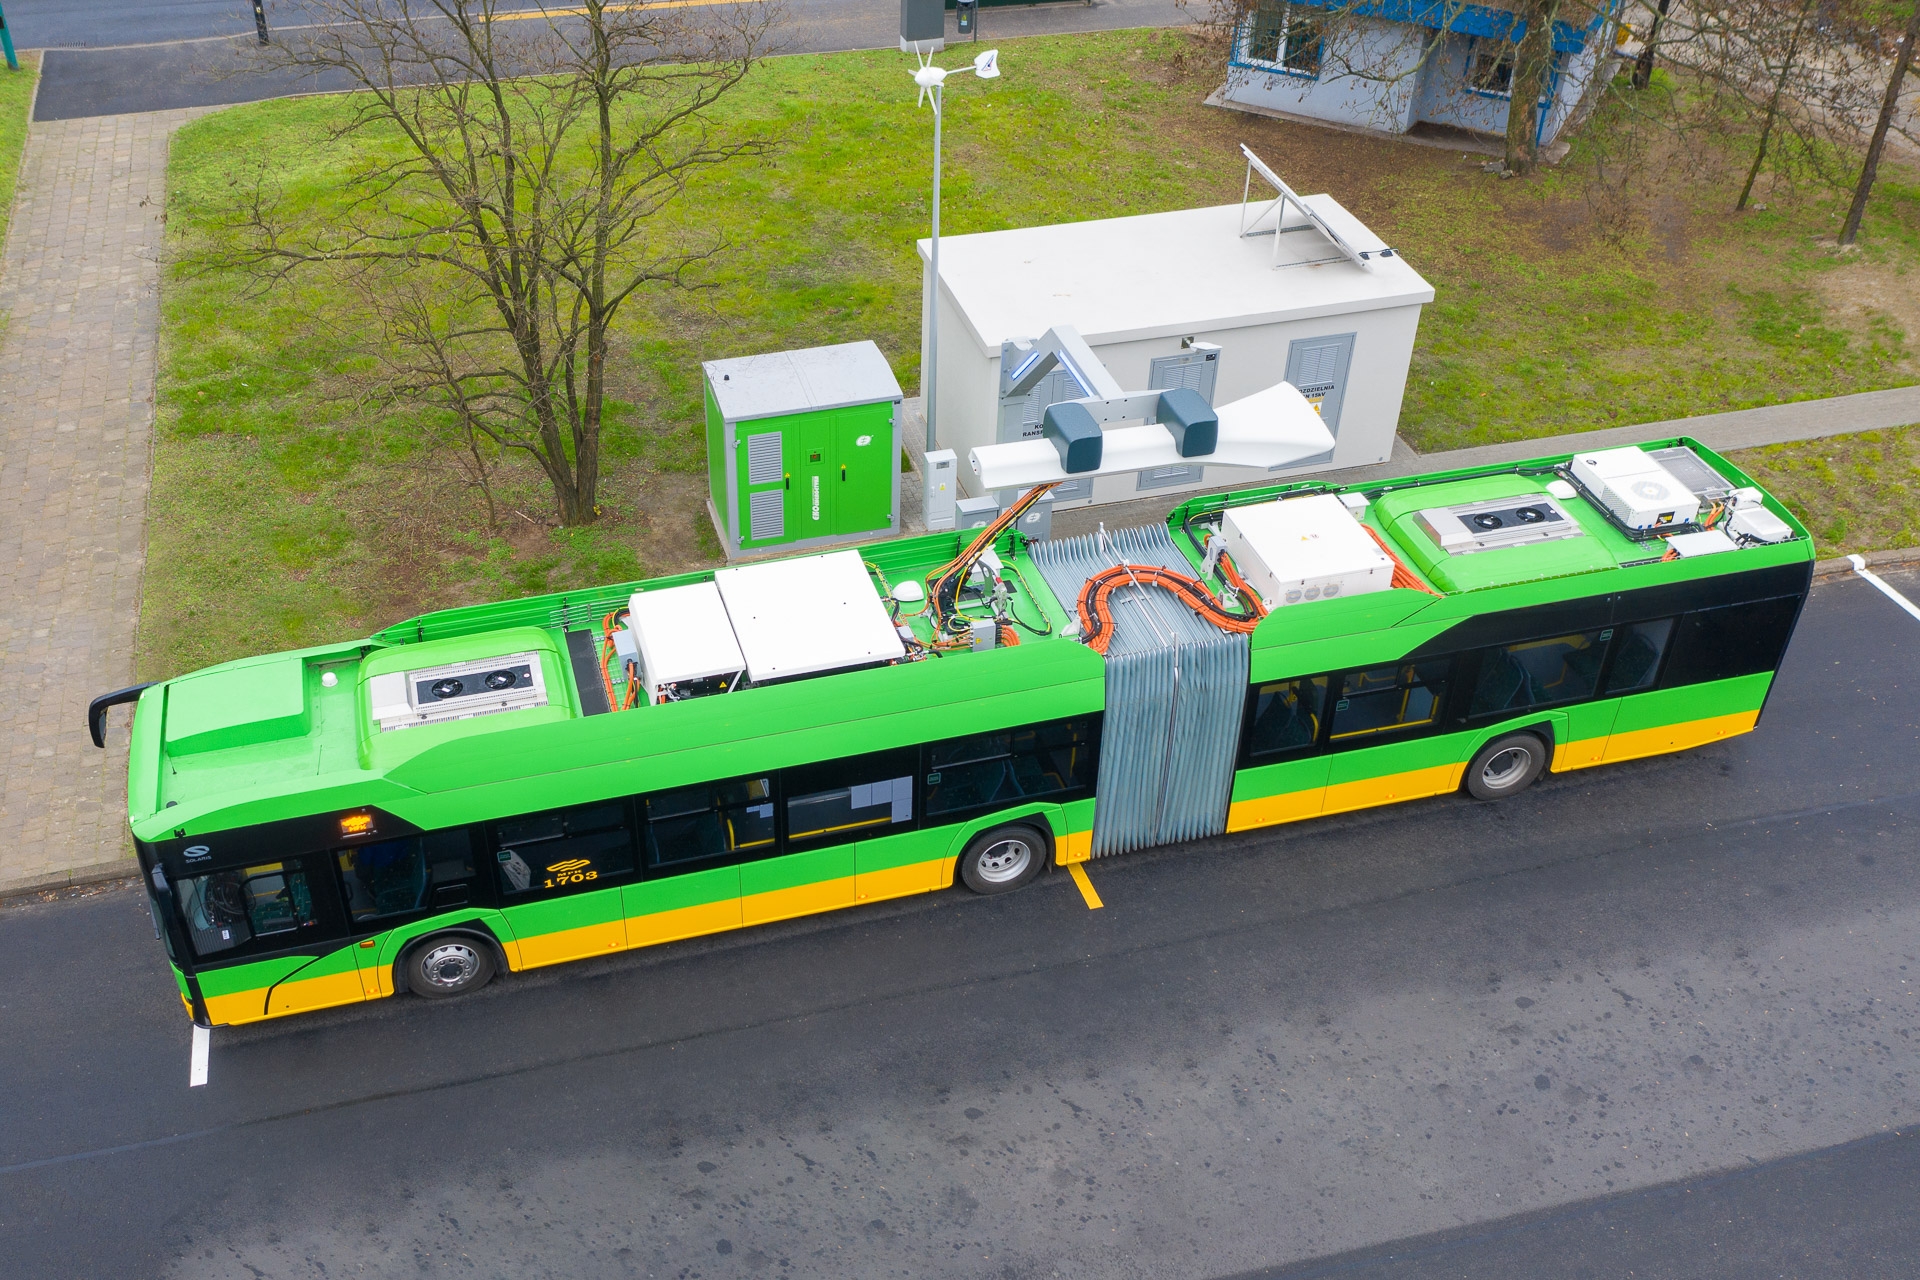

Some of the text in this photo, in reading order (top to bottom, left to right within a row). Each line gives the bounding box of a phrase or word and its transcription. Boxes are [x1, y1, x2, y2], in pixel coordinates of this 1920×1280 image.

[1298, 385, 1334, 394] OZDZIELNIA
[185, 856, 212, 864] SOLARIS
[544, 871, 598, 889] 1703
